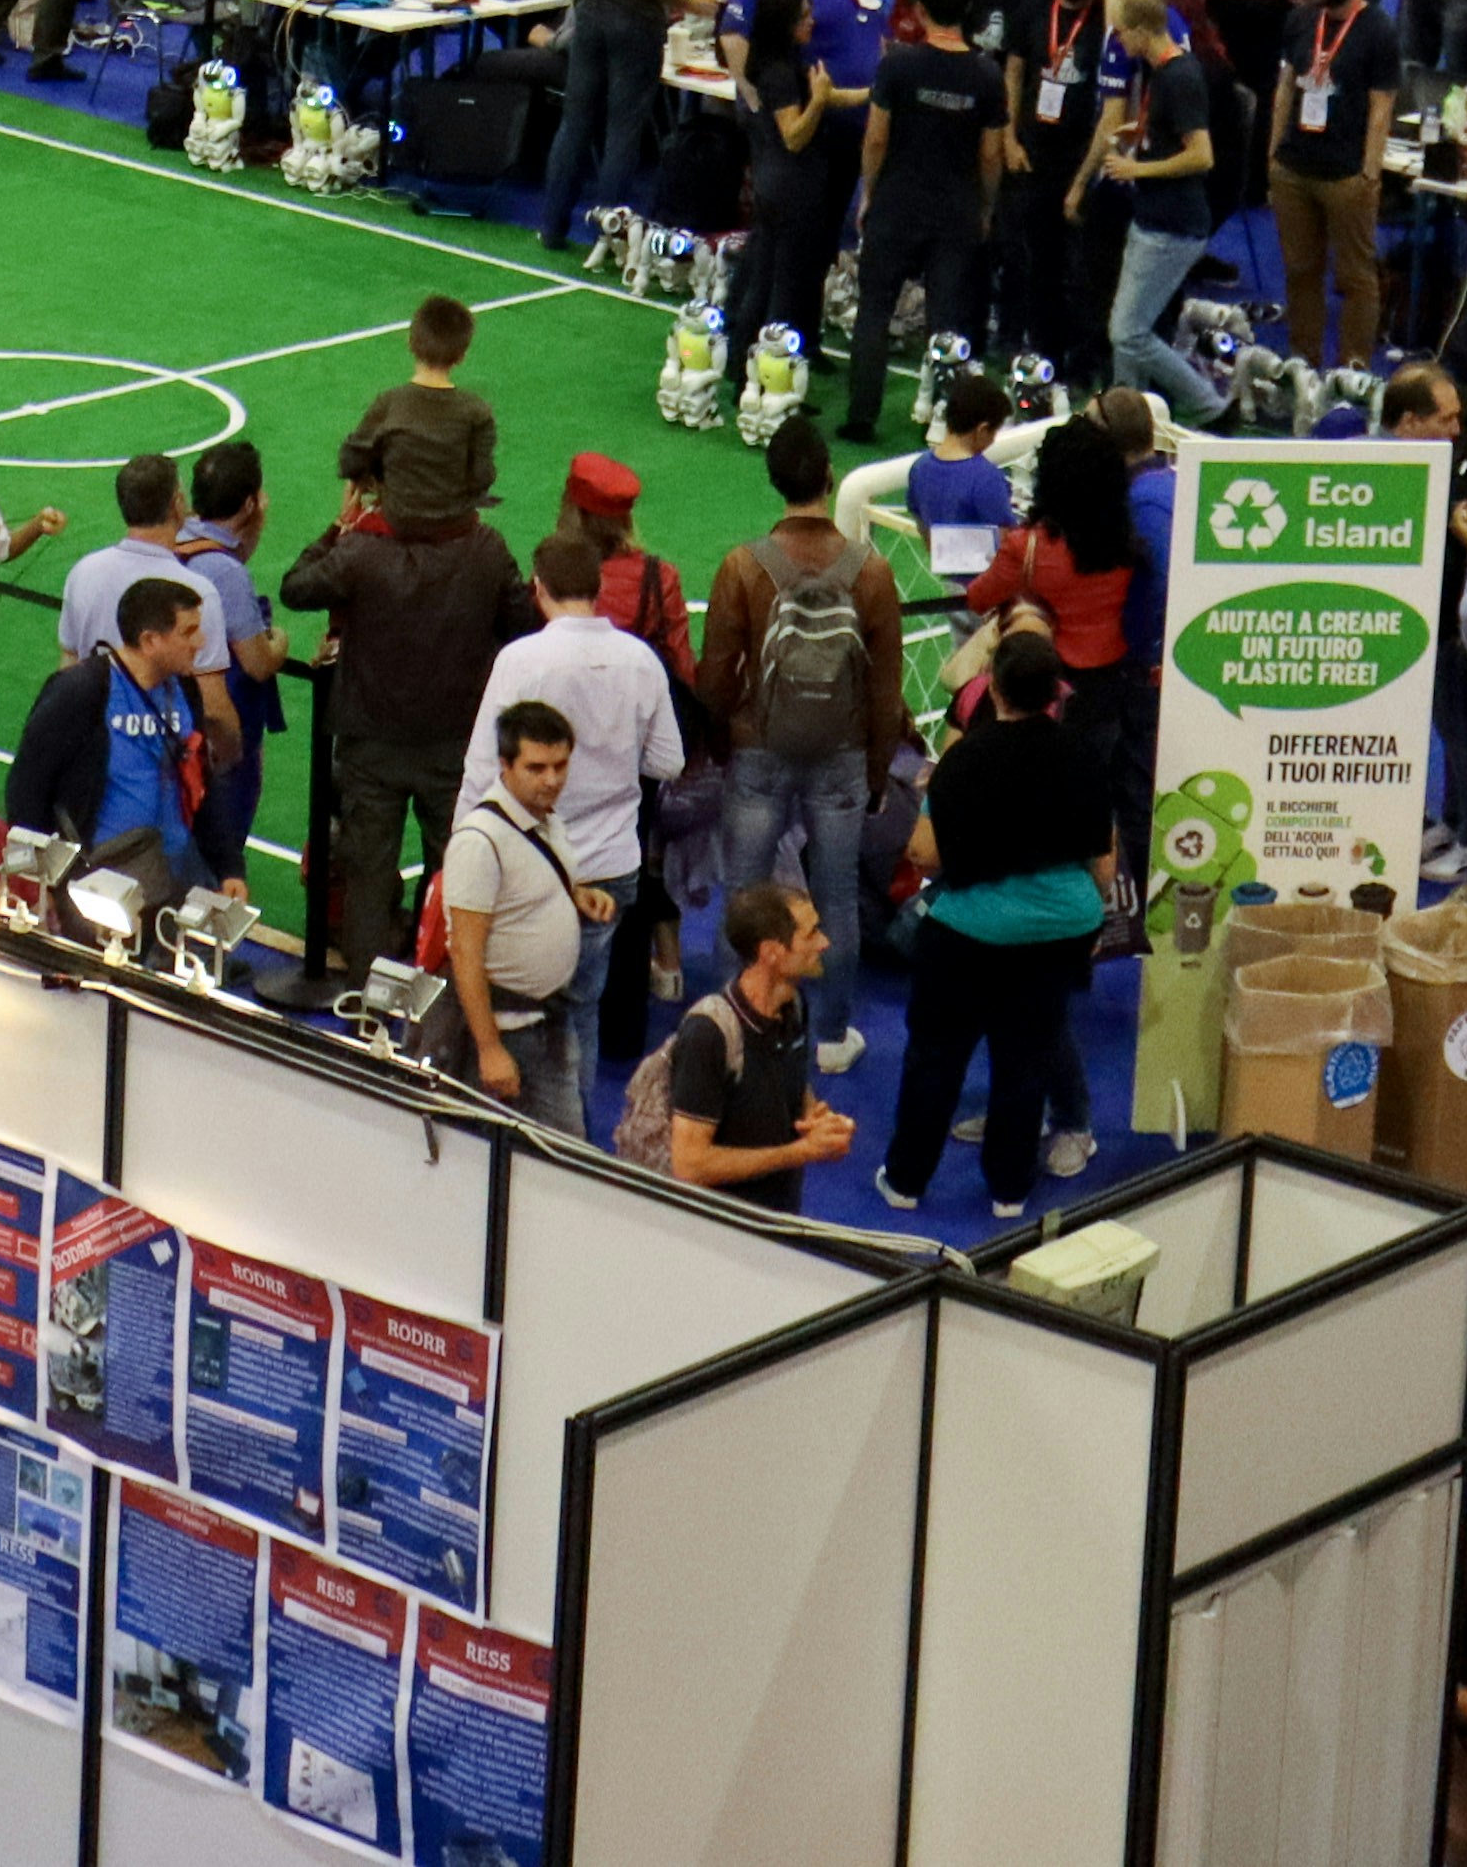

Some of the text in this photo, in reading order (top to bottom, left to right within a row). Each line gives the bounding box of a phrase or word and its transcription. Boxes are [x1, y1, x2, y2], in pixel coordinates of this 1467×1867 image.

[1308, 475, 1374, 507] Eco
[1304, 516, 1413, 549] Island
[1206, 610, 1403, 635] AIUTACI A CREARE
[1241, 636, 1364, 661] UN FUTURO
[1222, 661, 1379, 687] PLASTIC FREE!
[1268, 733, 1399, 758] DIFFERENZIA
[1267, 761, 1413, 785] I TUOI RIFIUTI!
[1267, 801, 1340, 815] IL BICCHIERE
[1265, 815, 1353, 830] COMPOSTABILE
[1264, 830, 1335, 845] DELL'ACQUA
[1263, 846, 1341, 862] GETTALO QUI!
[52, 1240, 95, 1273] RODRR
[231, 1261, 289, 1300] RODRR
[386, 1318, 447, 1357] RODRR
[0, 1537, 37, 1567] RESS
[316, 1575, 356, 1608] RESS
[465, 1640, 512, 1673] RESS
